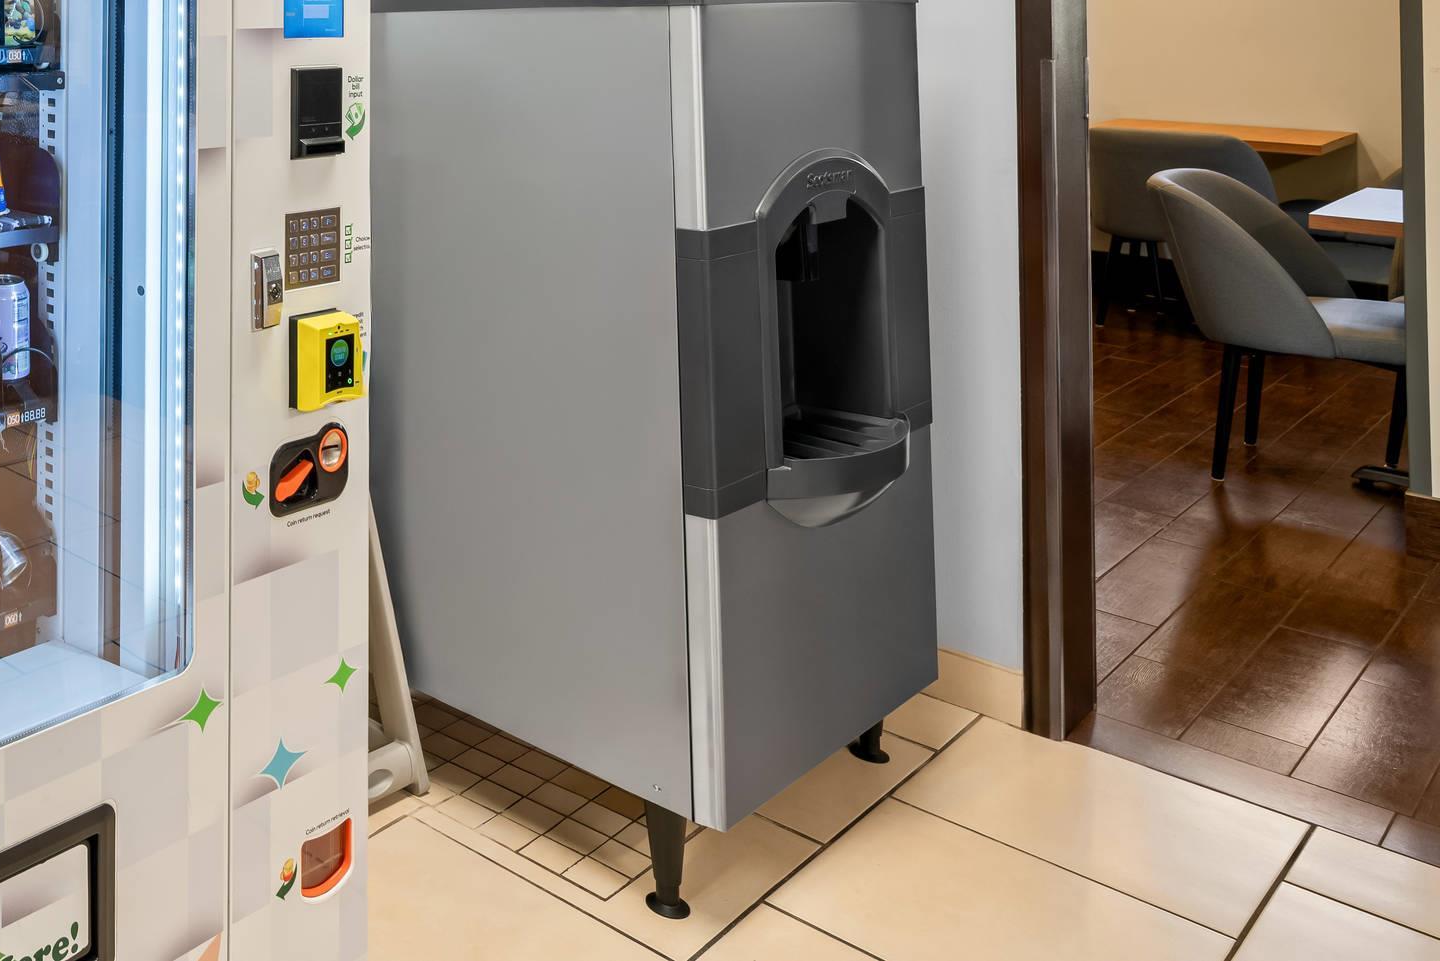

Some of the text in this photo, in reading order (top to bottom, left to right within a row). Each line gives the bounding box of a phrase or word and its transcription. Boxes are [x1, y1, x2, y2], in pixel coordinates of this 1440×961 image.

[8, 52, 21, 61] 030
[348, 90, 363, 98] input
[286, 508, 331, 528] Coin return request
[305, 826, 316, 836] Coin
